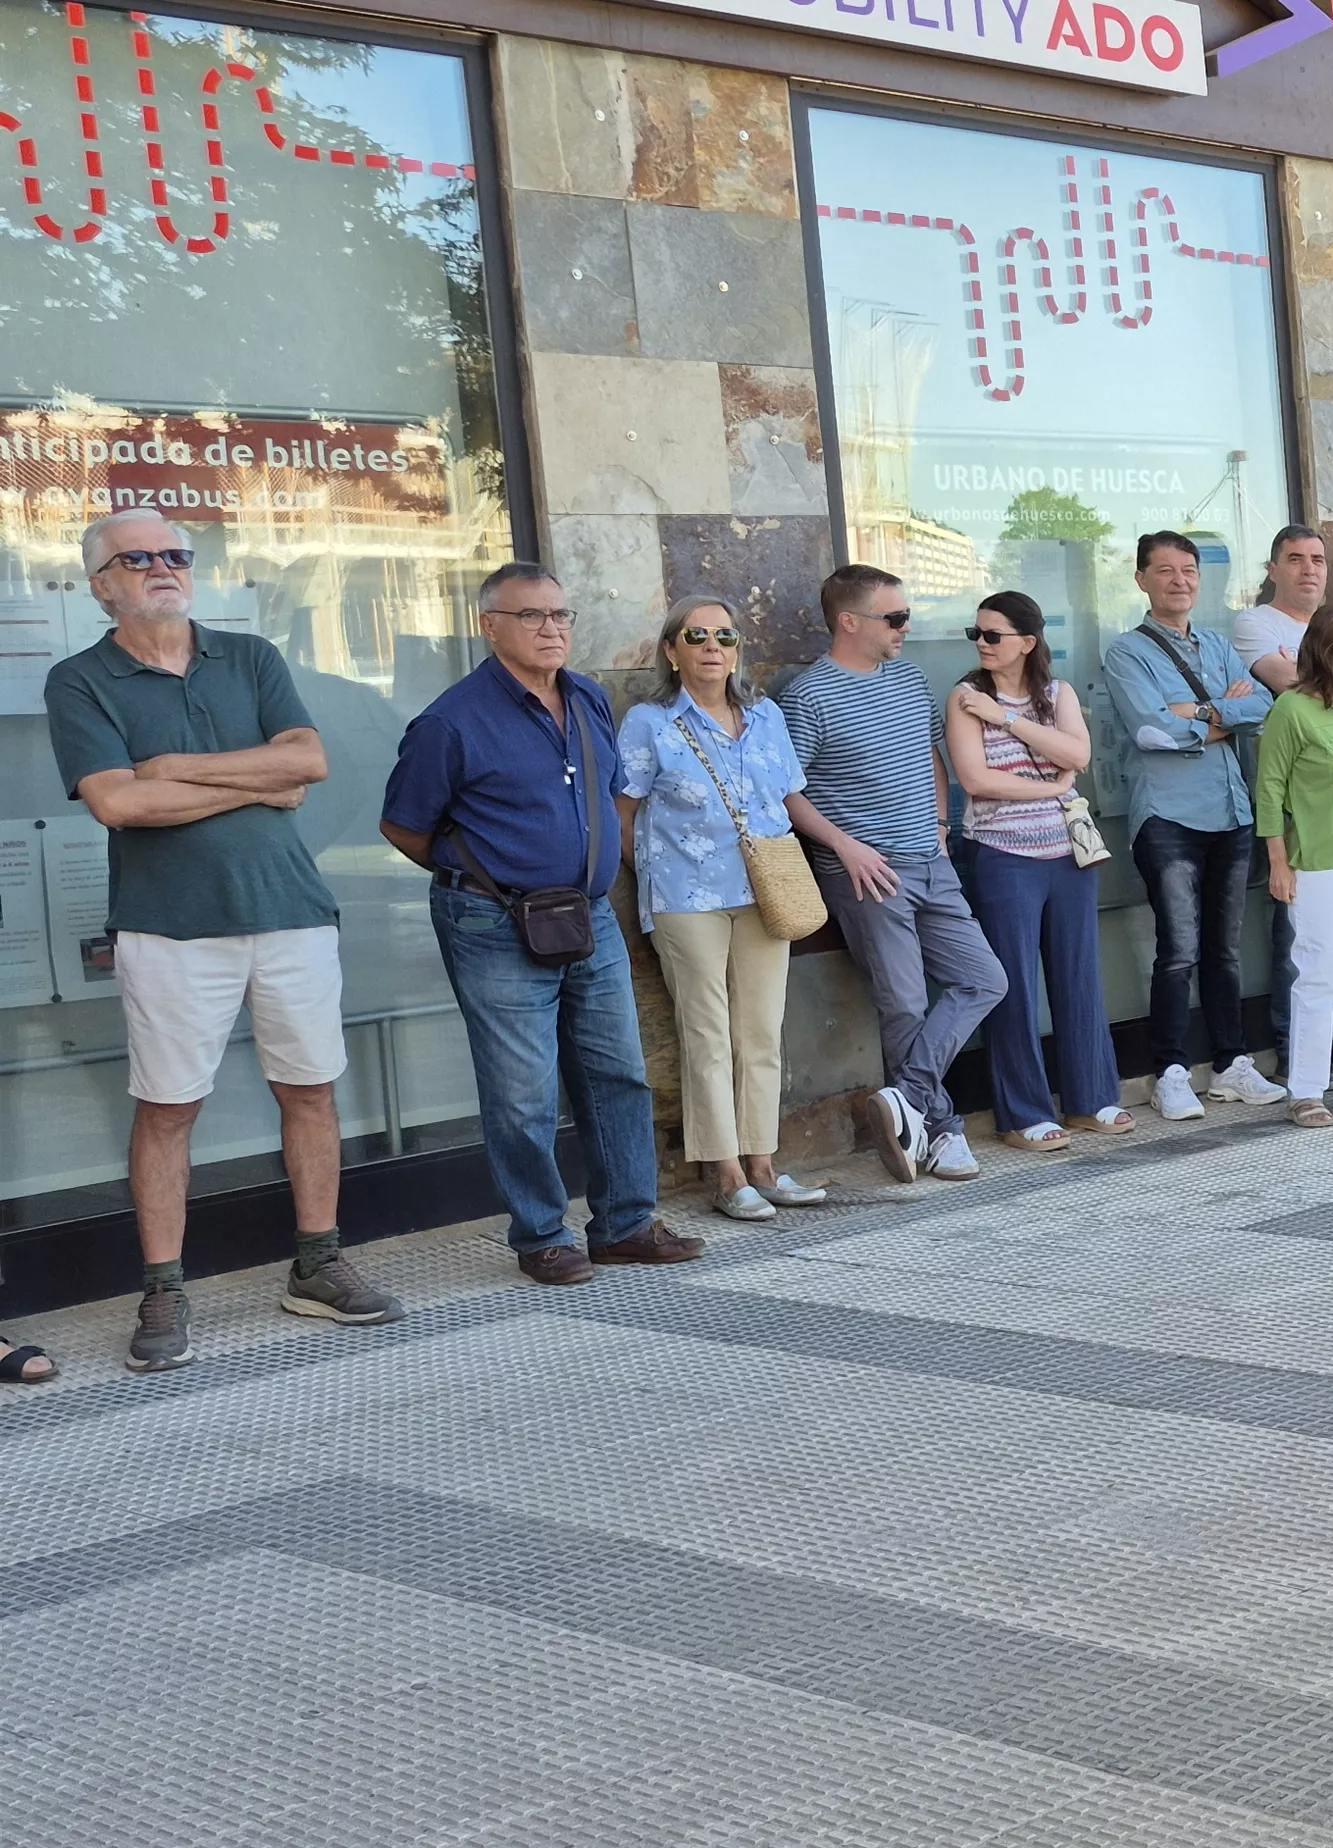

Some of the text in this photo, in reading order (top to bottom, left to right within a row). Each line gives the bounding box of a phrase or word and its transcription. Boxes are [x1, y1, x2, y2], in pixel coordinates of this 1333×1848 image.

[1045, 0, 1184, 72] ADO
[204, 436, 254, 468] de
[266, 438, 410, 473] billetes
[934, 464, 1186, 496] URBANO DE HUESCA
